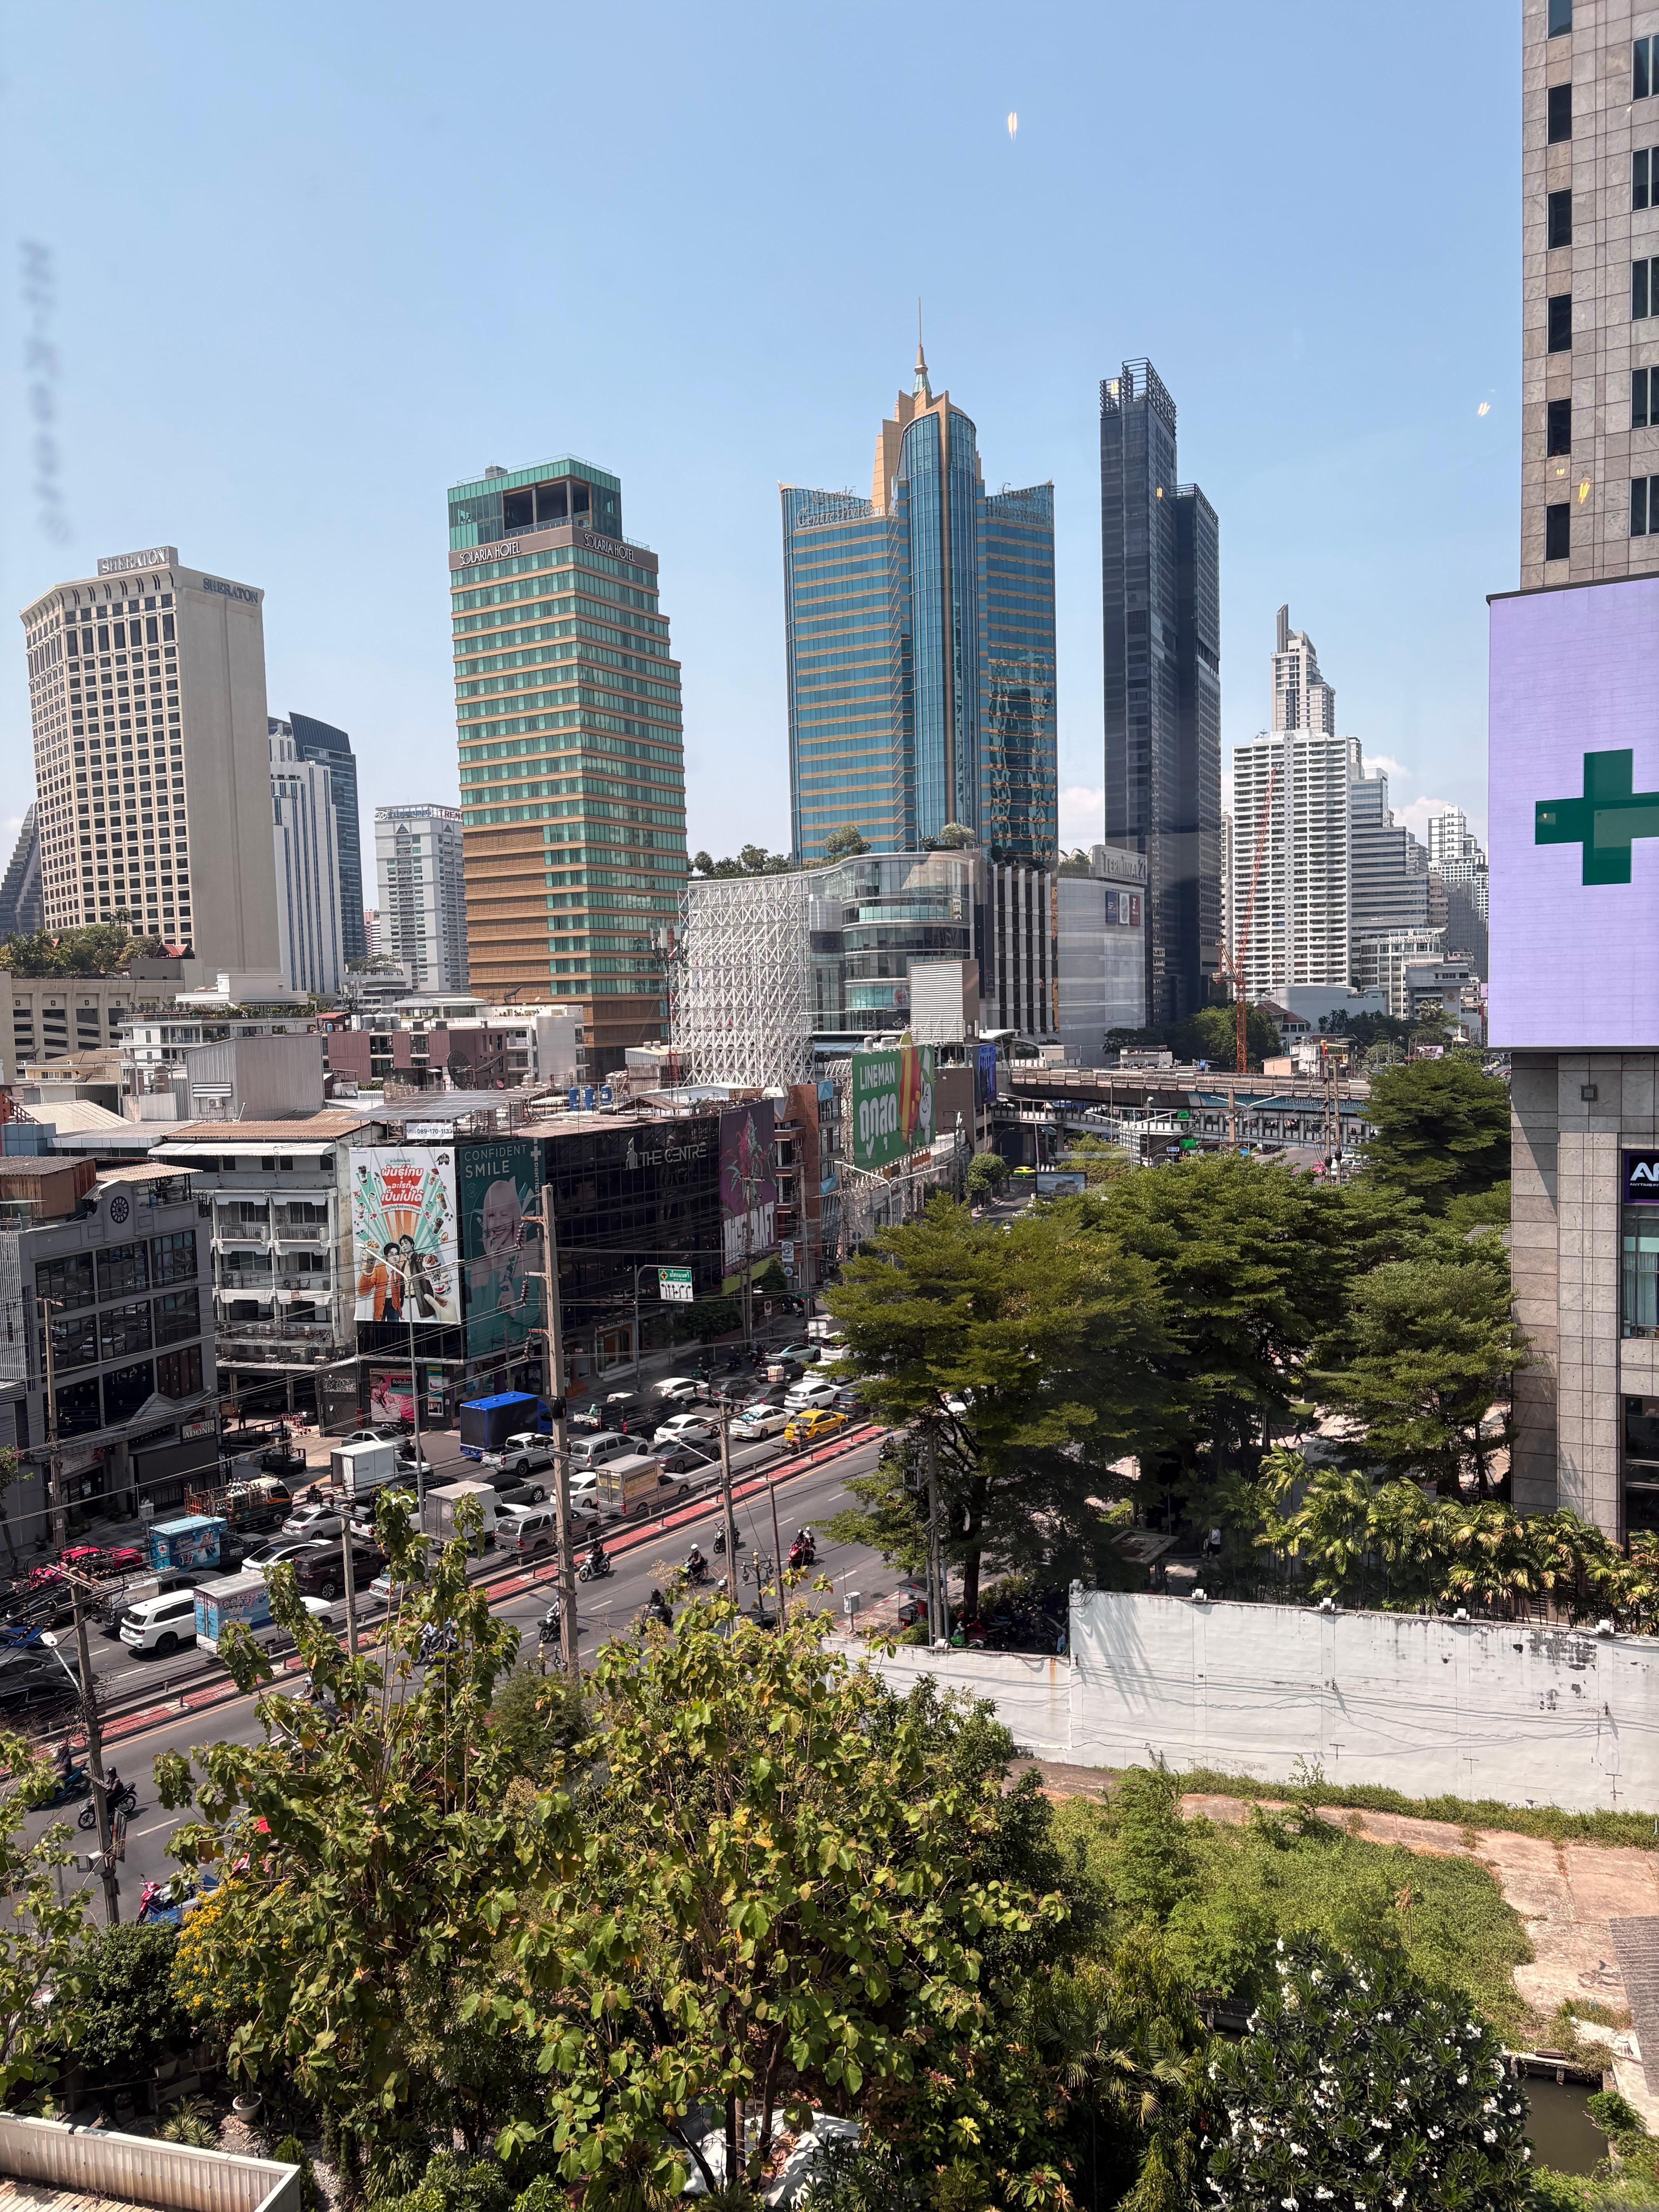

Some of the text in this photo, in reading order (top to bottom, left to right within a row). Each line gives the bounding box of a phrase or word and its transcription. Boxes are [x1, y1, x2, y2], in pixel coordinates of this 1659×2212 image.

[460, 541, 521, 566] SOLARIA HOTEL
[584, 533, 635, 562] SOLARIA HOTEL
[102, 548, 166, 574] SHERATON
[203, 577, 258, 603] SHERATON
[1102, 851, 1146, 879] TERMINAL 21
[859, 1093, 897, 1159] ถูกสุด
[465, 1145, 527, 1161] CONFIDENT
[639, 1142, 707, 1167] THE CENTRE
[381, 1164, 423, 1180] พันธุ์ไทย
[465, 1160, 510, 1178] SMILE
[381, 1189, 424, 1202] เป็นไปได้
[184, 1425, 215, 1439] ADONIS
